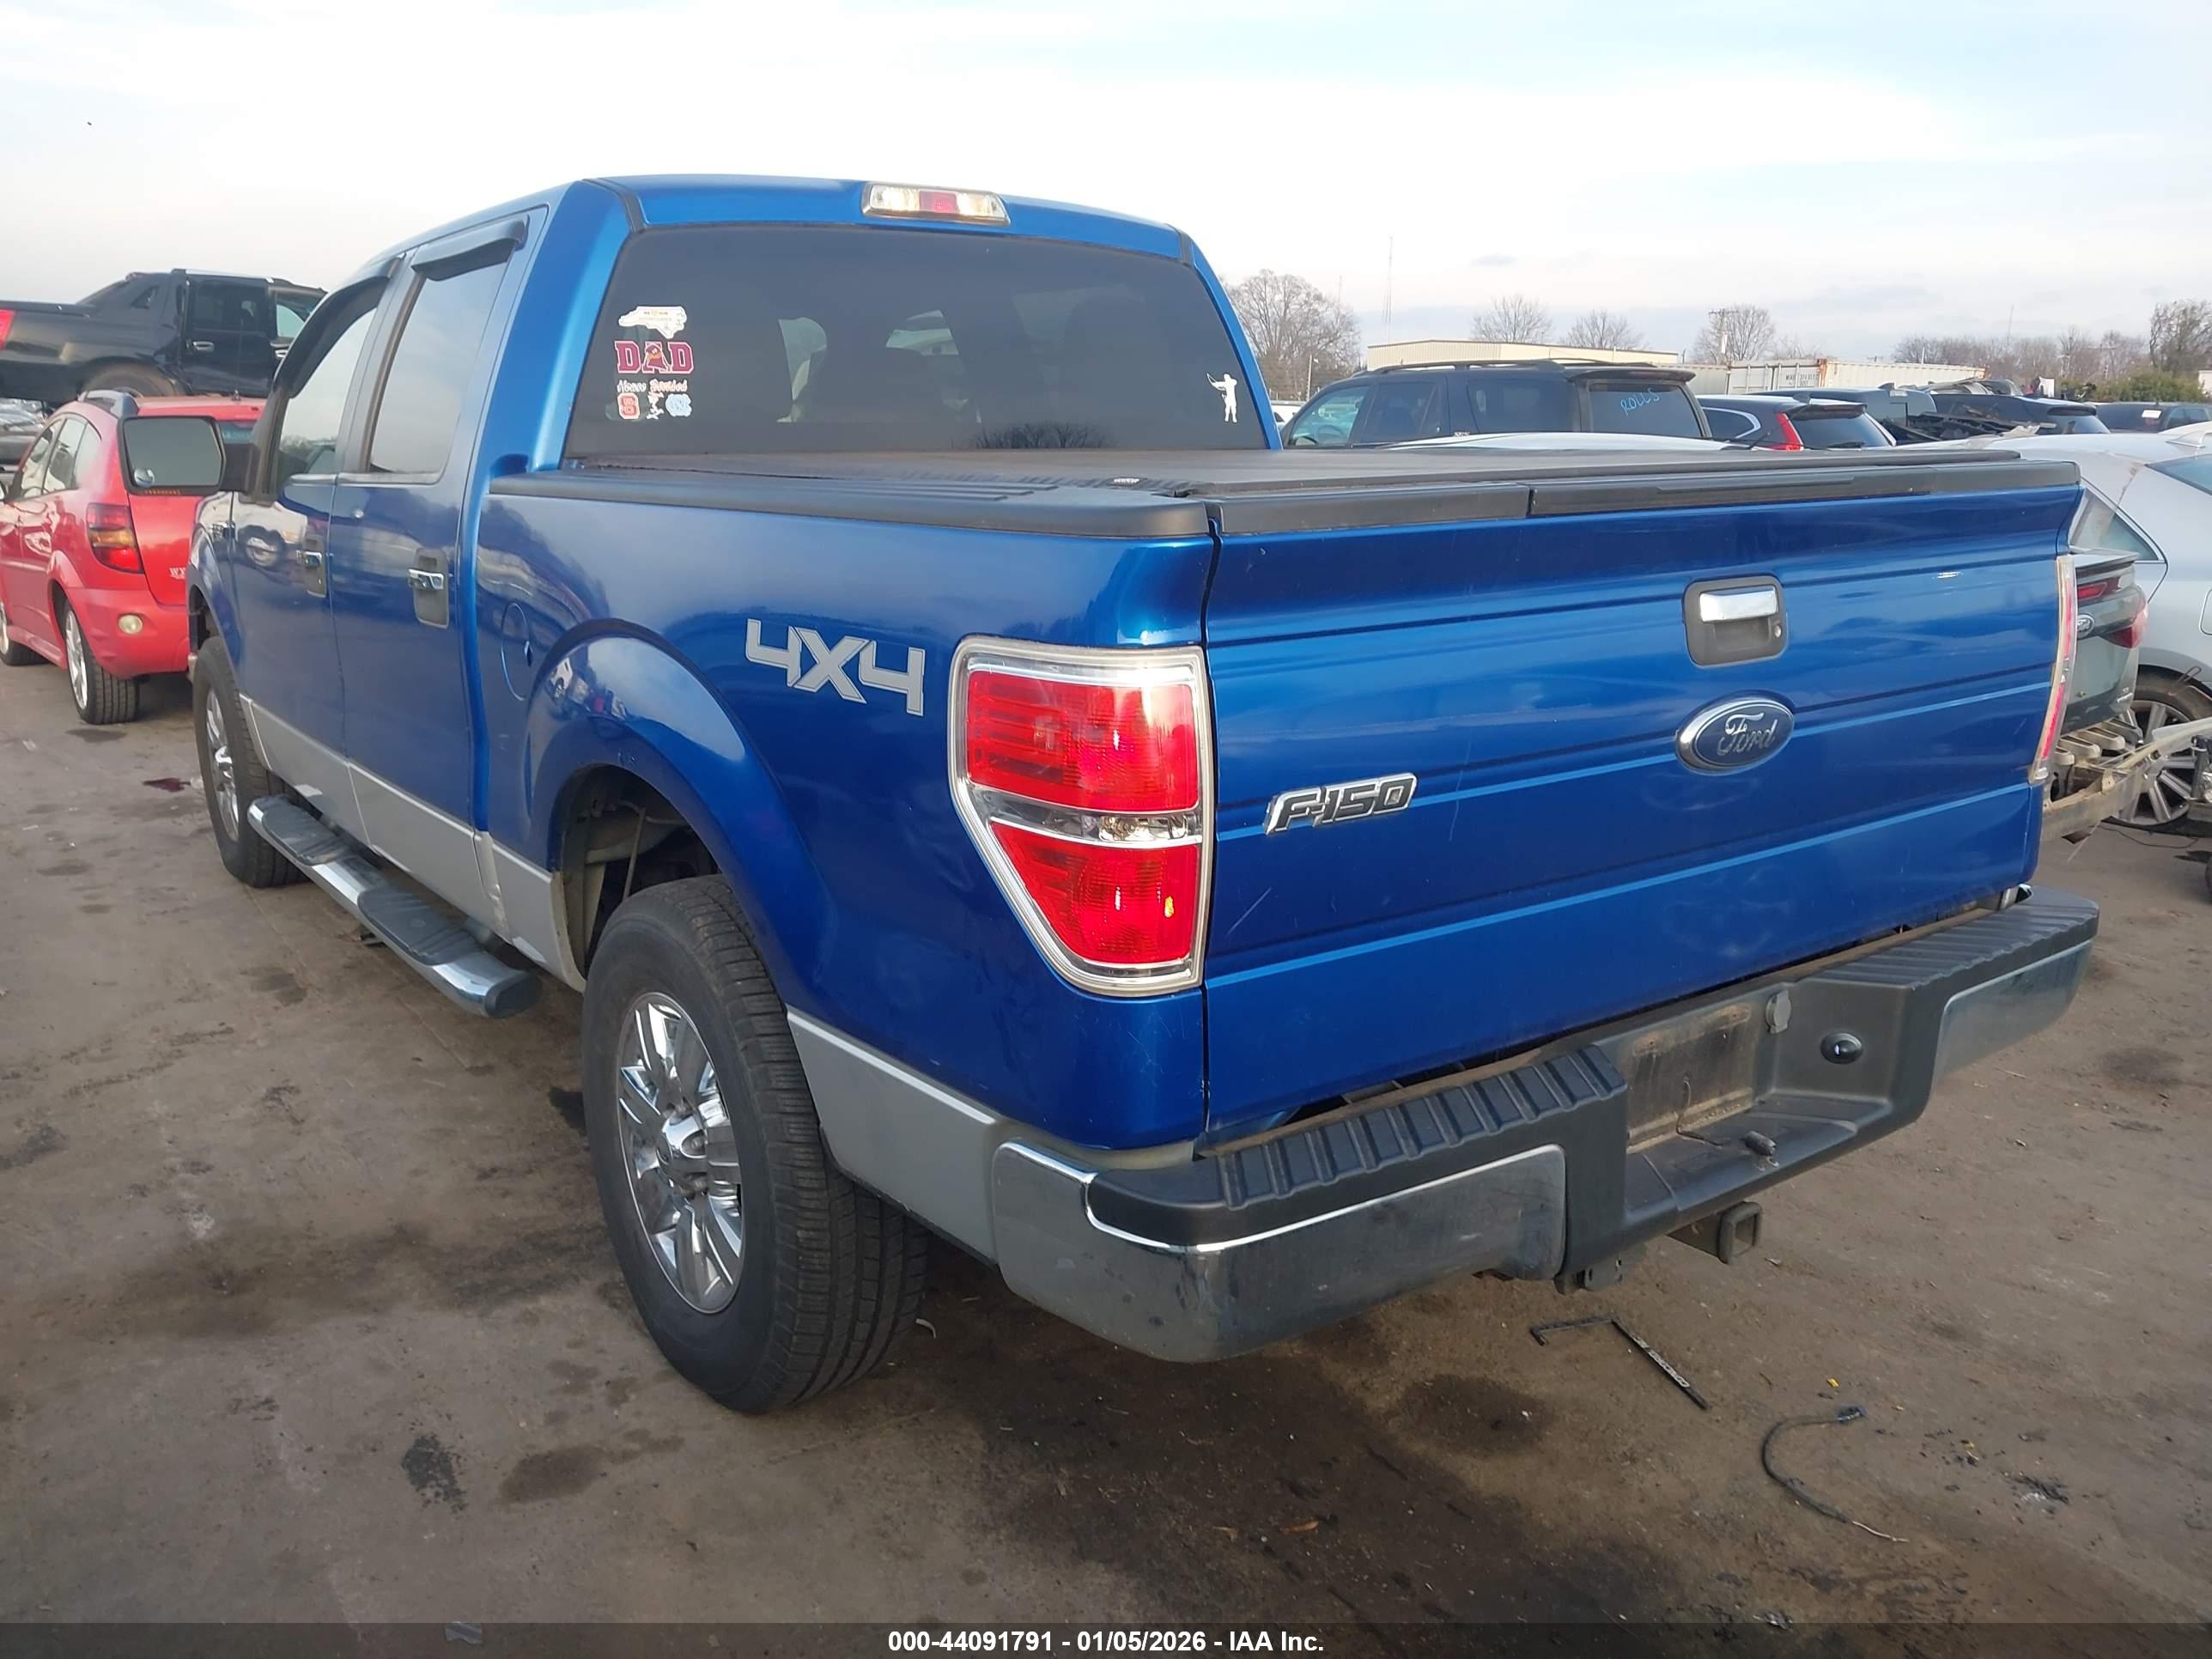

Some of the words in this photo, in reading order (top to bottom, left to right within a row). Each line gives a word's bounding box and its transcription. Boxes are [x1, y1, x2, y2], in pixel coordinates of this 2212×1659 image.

[615, 341, 694, 374] DAD
[1717, 713, 1778, 757] Ford
[1264, 773, 1417, 836] F-150
